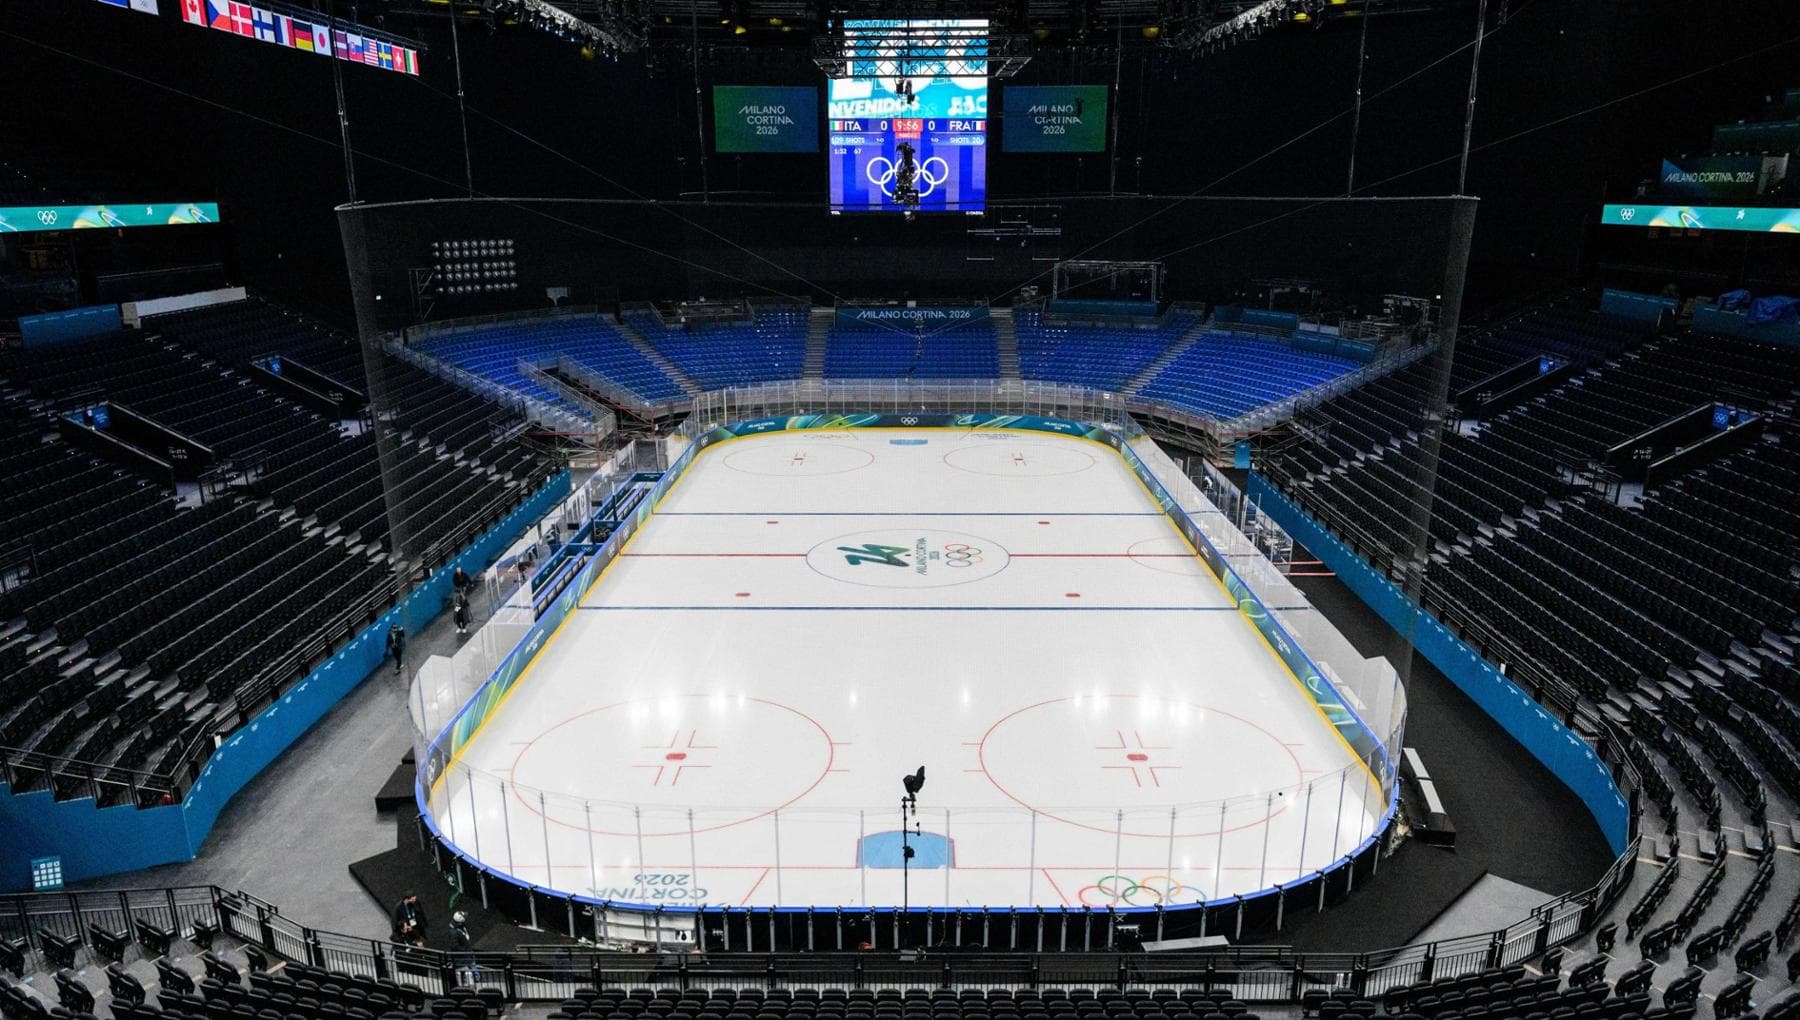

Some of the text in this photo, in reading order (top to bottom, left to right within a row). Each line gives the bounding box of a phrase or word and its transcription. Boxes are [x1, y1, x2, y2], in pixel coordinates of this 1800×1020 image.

[738, 105, 785, 114] MILANO
[746, 115, 794, 125] CORTINA
[756, 126, 778, 135] 2026
[844, 121, 861, 131] ITA
[880, 121, 888, 131] 0
[928, 121, 936, 131] 0
[949, 121, 971, 131] FRA
[1042, 125, 1065, 135] 2026
[1663, 171, 1755, 183] MILANO CORTINA 2026
[856, 310, 970, 319] MILANO CORTINA 2026
[586, 887, 709, 900] CORTINA
